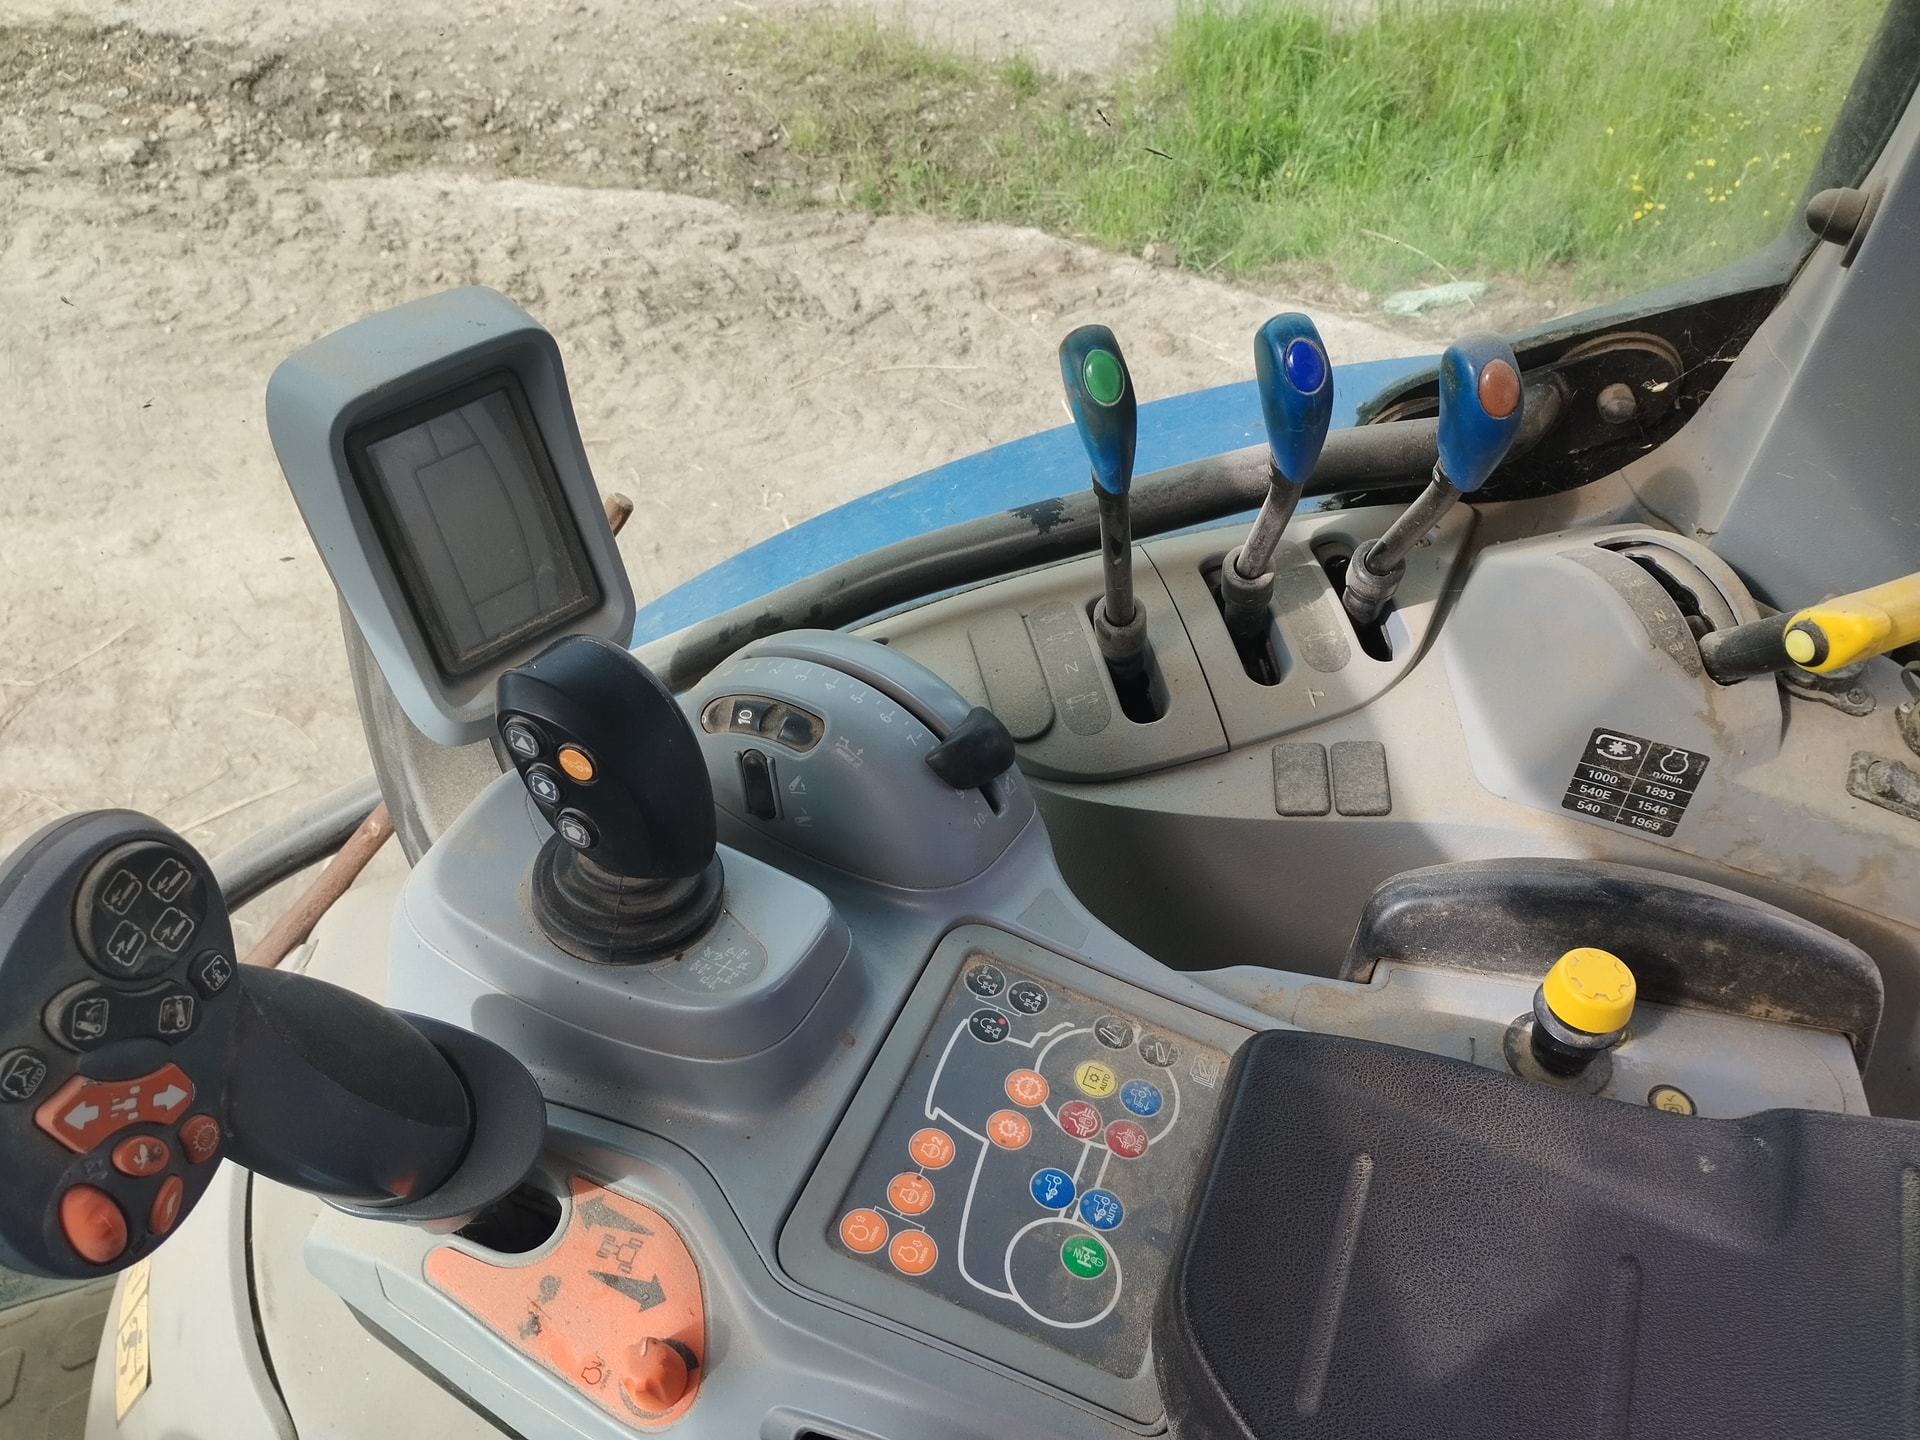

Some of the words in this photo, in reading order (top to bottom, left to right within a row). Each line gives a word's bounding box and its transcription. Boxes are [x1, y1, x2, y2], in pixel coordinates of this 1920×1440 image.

[1654, 609, 1667, 621] N
[1064, 661, 1078, 674] N
[850, 694, 863, 704] 5
[738, 709, 753, 725] 10
[879, 713, 892, 724] 6
[906, 734, 917, 746] 7
[1588, 769, 1619, 784] 1000
[1652, 771, 1684, 785] n/min
[1579, 784, 1612, 800] 540E
[1645, 785, 1676, 800] 1893
[1576, 800, 1601, 814] 540
[1638, 800, 1669, 816] 1546
[973, 812, 987, 830] 10
[1631, 815, 1661, 831] 1969
[24, 1067, 43, 1096] AUTO
[1024, 1079, 1034, 1096] AUTO
[1100, 1073, 1111, 1092] AUTO
[931, 1136, 944, 1146] 2
[1134, 1134, 1145, 1154] AUTO
[911, 1181, 923, 1189] 1
[1105, 1202, 1119, 1225] AUTO
